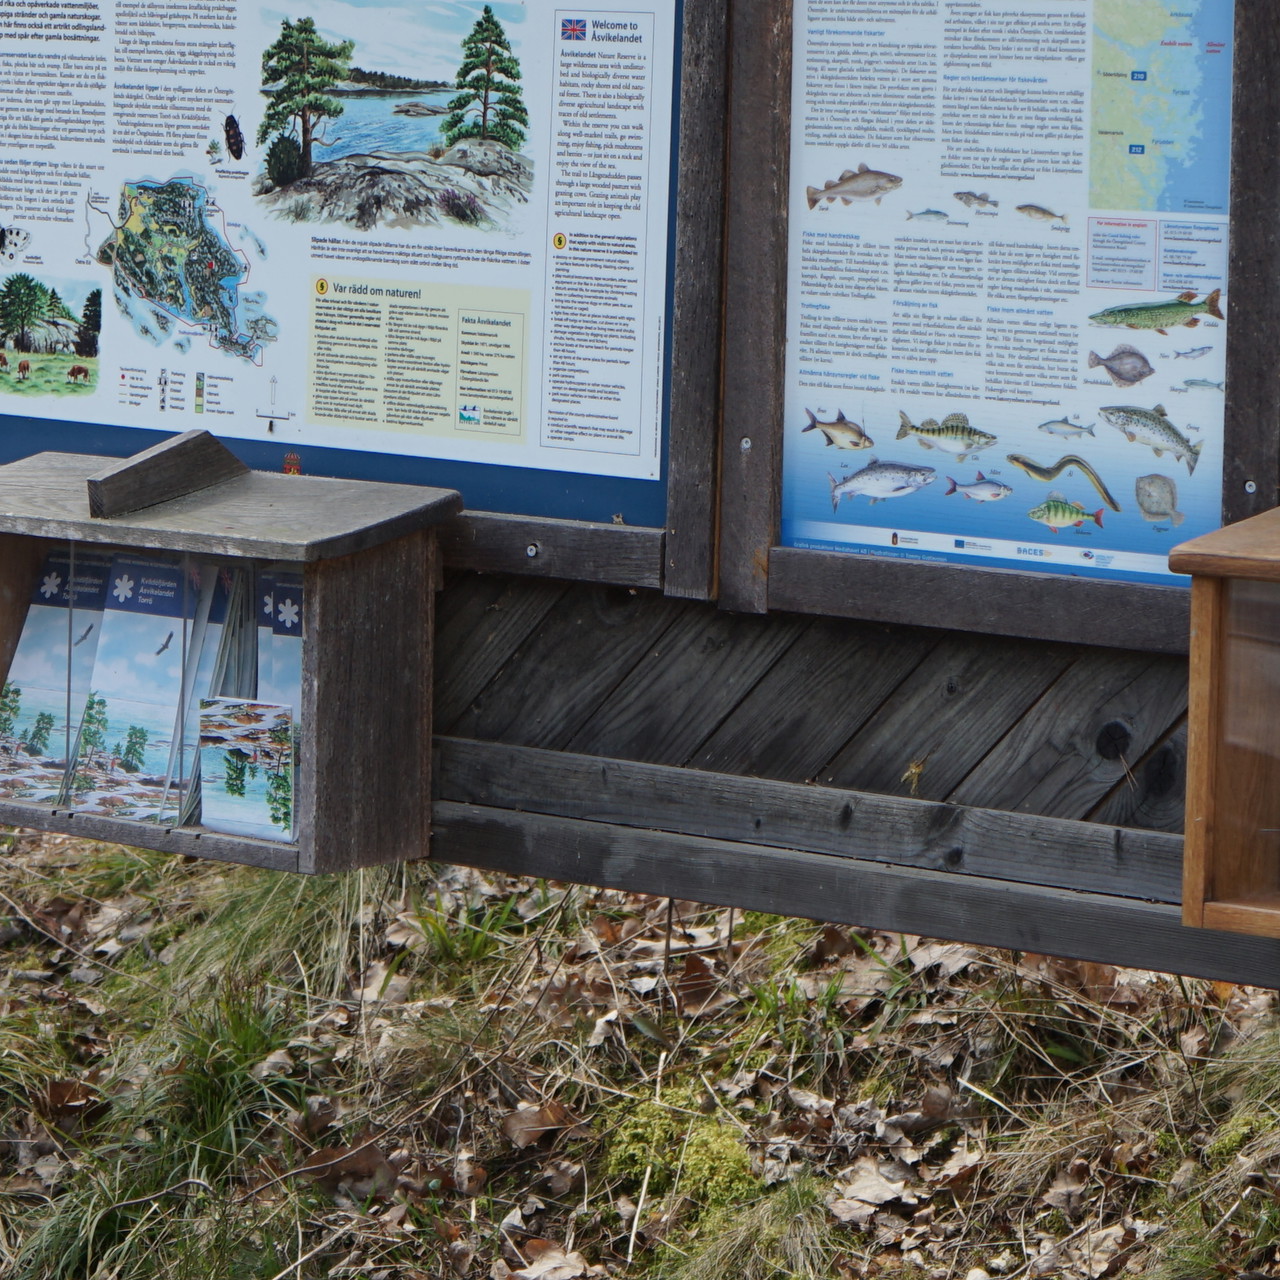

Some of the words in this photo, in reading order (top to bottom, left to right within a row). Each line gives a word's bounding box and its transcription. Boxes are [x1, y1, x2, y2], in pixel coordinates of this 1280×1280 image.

[27, 1, 60, 10] opåverkade
[49, 12, 67, 21] gamla
[67, 12, 102, 22] naturskogar.
[72, 23, 107, 33] odlingsland-
[591, 20, 628, 30] Welcome
[629, 21, 638, 31] to
[18, 32, 30, 41] spår
[31, 32, 44, 40] efter
[45, 33, 62, 42] gamla
[591, 30, 642, 43] Åsvikelandet
[333, 283, 347, 293] Var
[348, 284, 368, 295] rädd
[369, 287, 384, 296] om
[385, 289, 421, 299] naturen!
[477, 316, 512, 327] Åsvikelandet
[139, 586, 175, 598] Åsvikelandet
[138, 596, 153, 605] Torrö
